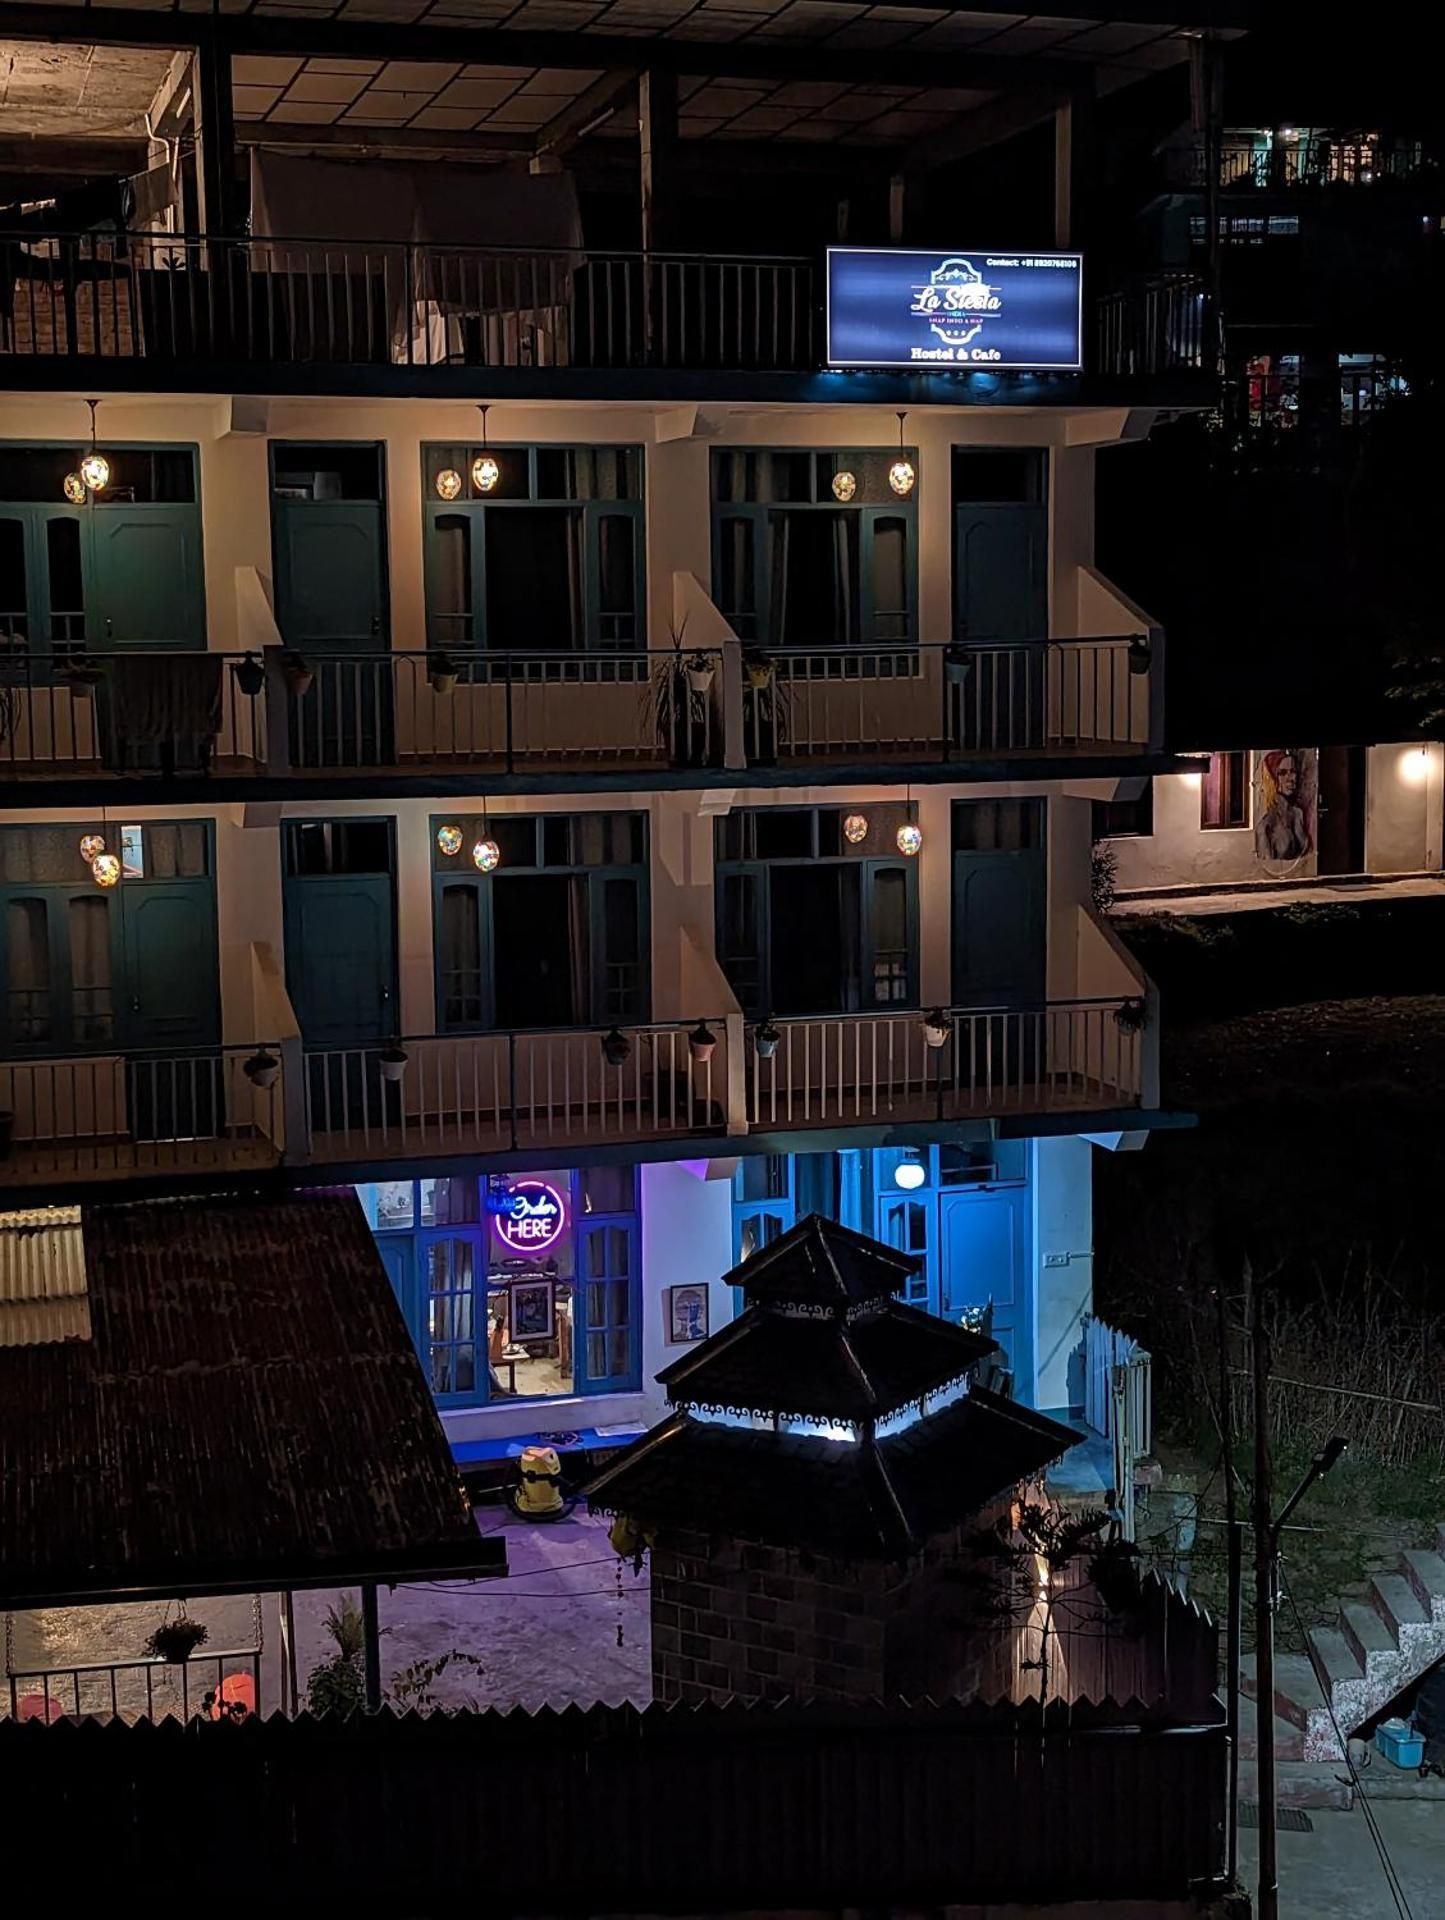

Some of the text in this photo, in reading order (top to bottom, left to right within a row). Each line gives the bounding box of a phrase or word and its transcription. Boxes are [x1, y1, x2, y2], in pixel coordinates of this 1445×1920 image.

[911, 287, 1001, 312] La Siesta
[911, 347, 1001, 360] Hostel & Cafe
[507, 1218, 552, 1239] HERE
